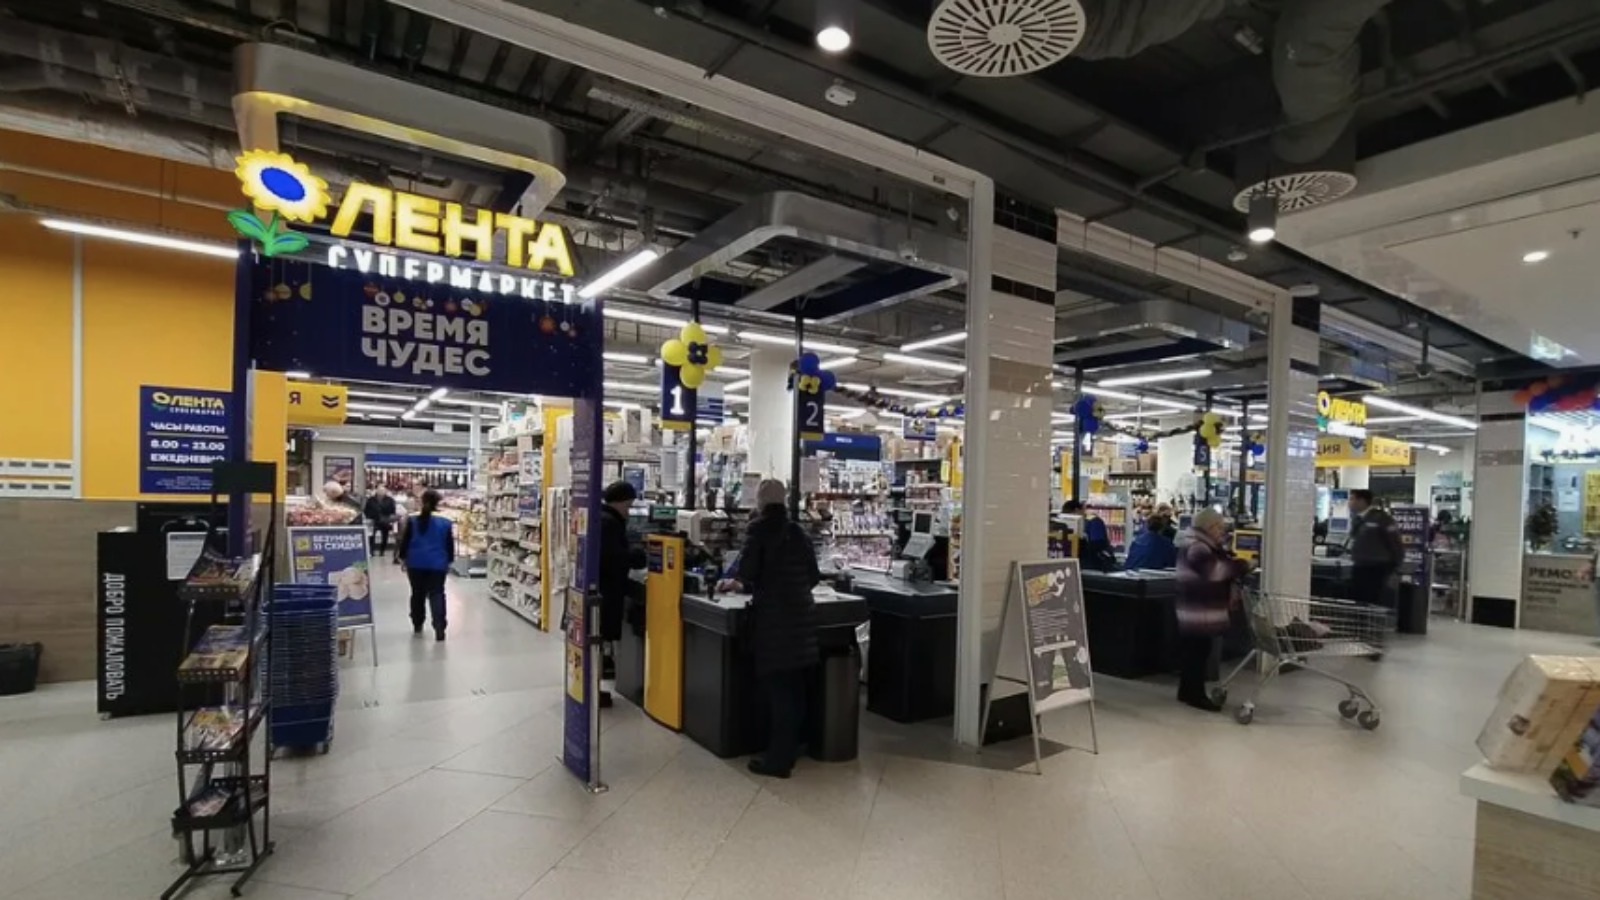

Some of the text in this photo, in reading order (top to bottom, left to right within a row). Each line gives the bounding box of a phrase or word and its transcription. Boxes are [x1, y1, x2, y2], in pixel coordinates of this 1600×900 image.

[330, 181, 575, 276] ЛЕНТА
[328, 245, 577, 304] СУПЕРМАРКЕТ
[361, 305, 488, 346] ВРЕМЯ
[361, 337, 491, 376] ЧУДЕС
[171, 395, 224, 408] ЛЕНТА
[670, 385, 684, 415] 1
[806, 401, 818, 426] 2
[150, 421, 225, 433] ЧАСЫ РАБОТЫ
[192, 441, 225, 451] 23.00
[103, 572, 125, 700] ДОБРО ПОЖАЛОВАТЬ
